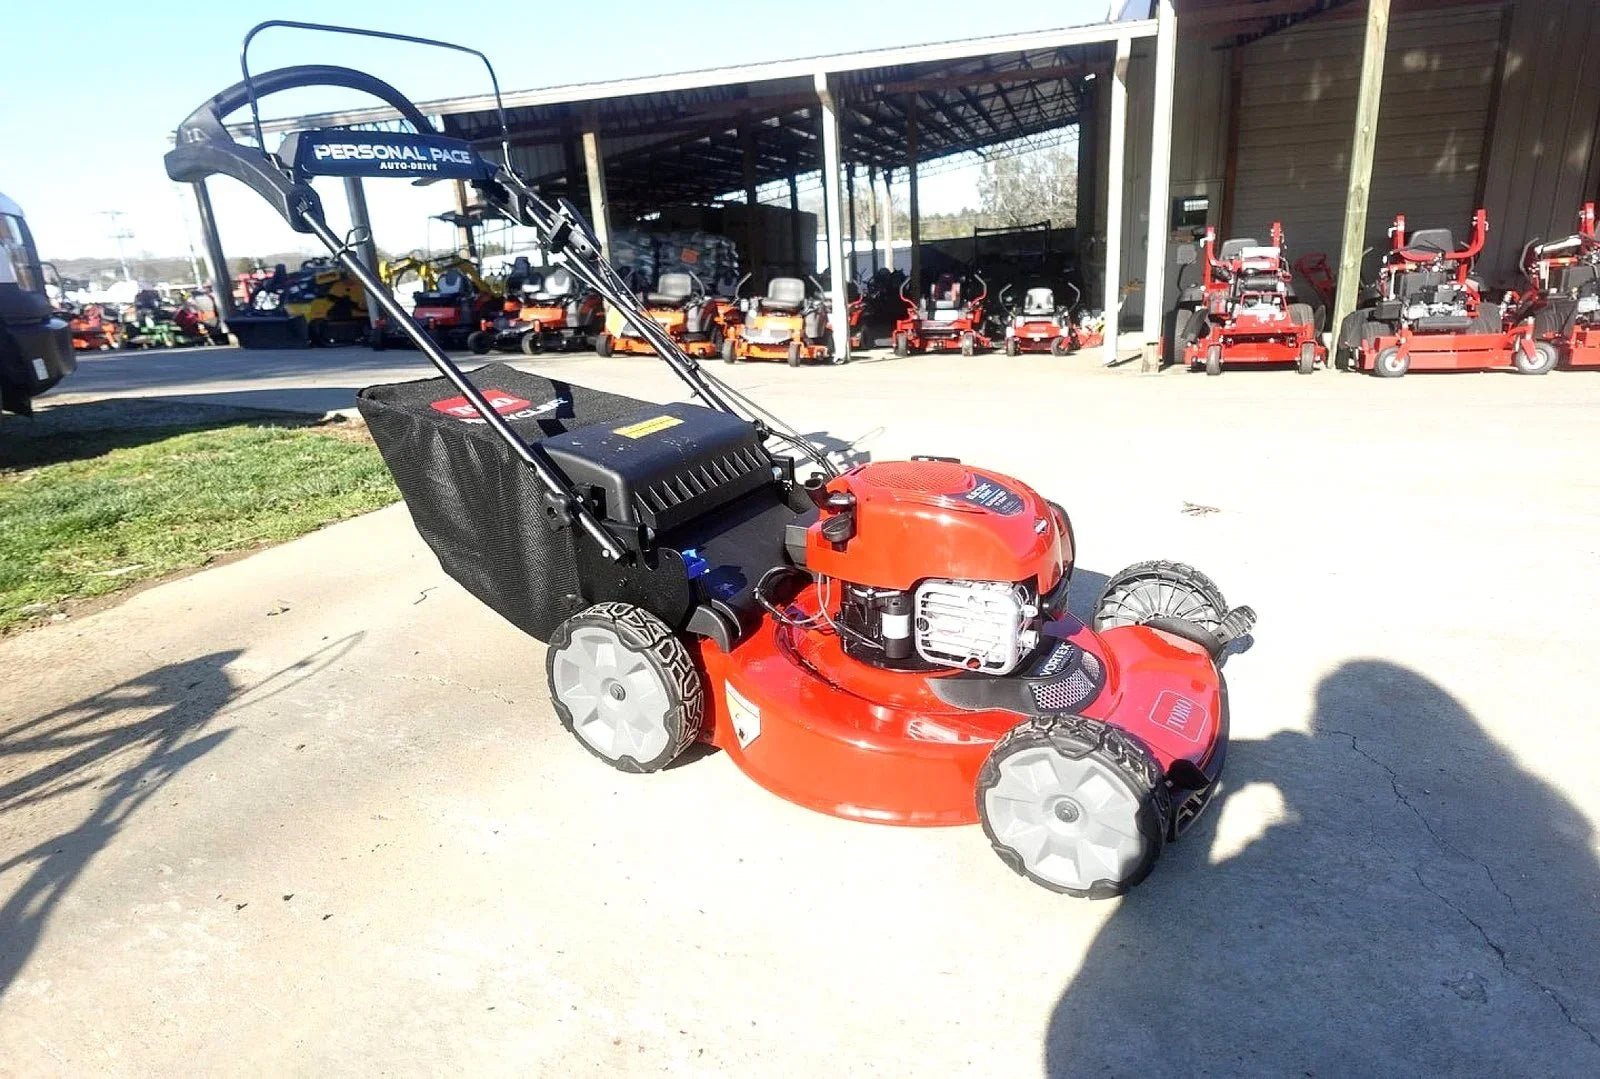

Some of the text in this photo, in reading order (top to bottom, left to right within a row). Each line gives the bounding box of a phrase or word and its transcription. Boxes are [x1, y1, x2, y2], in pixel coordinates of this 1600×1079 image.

[313, 144, 472, 164] PERSONAL PACE
[380, 161, 438, 171] AUTO-DRIVE
[1040, 642, 1072, 676] VORTEX
[1166, 699, 1191, 730] TORO
